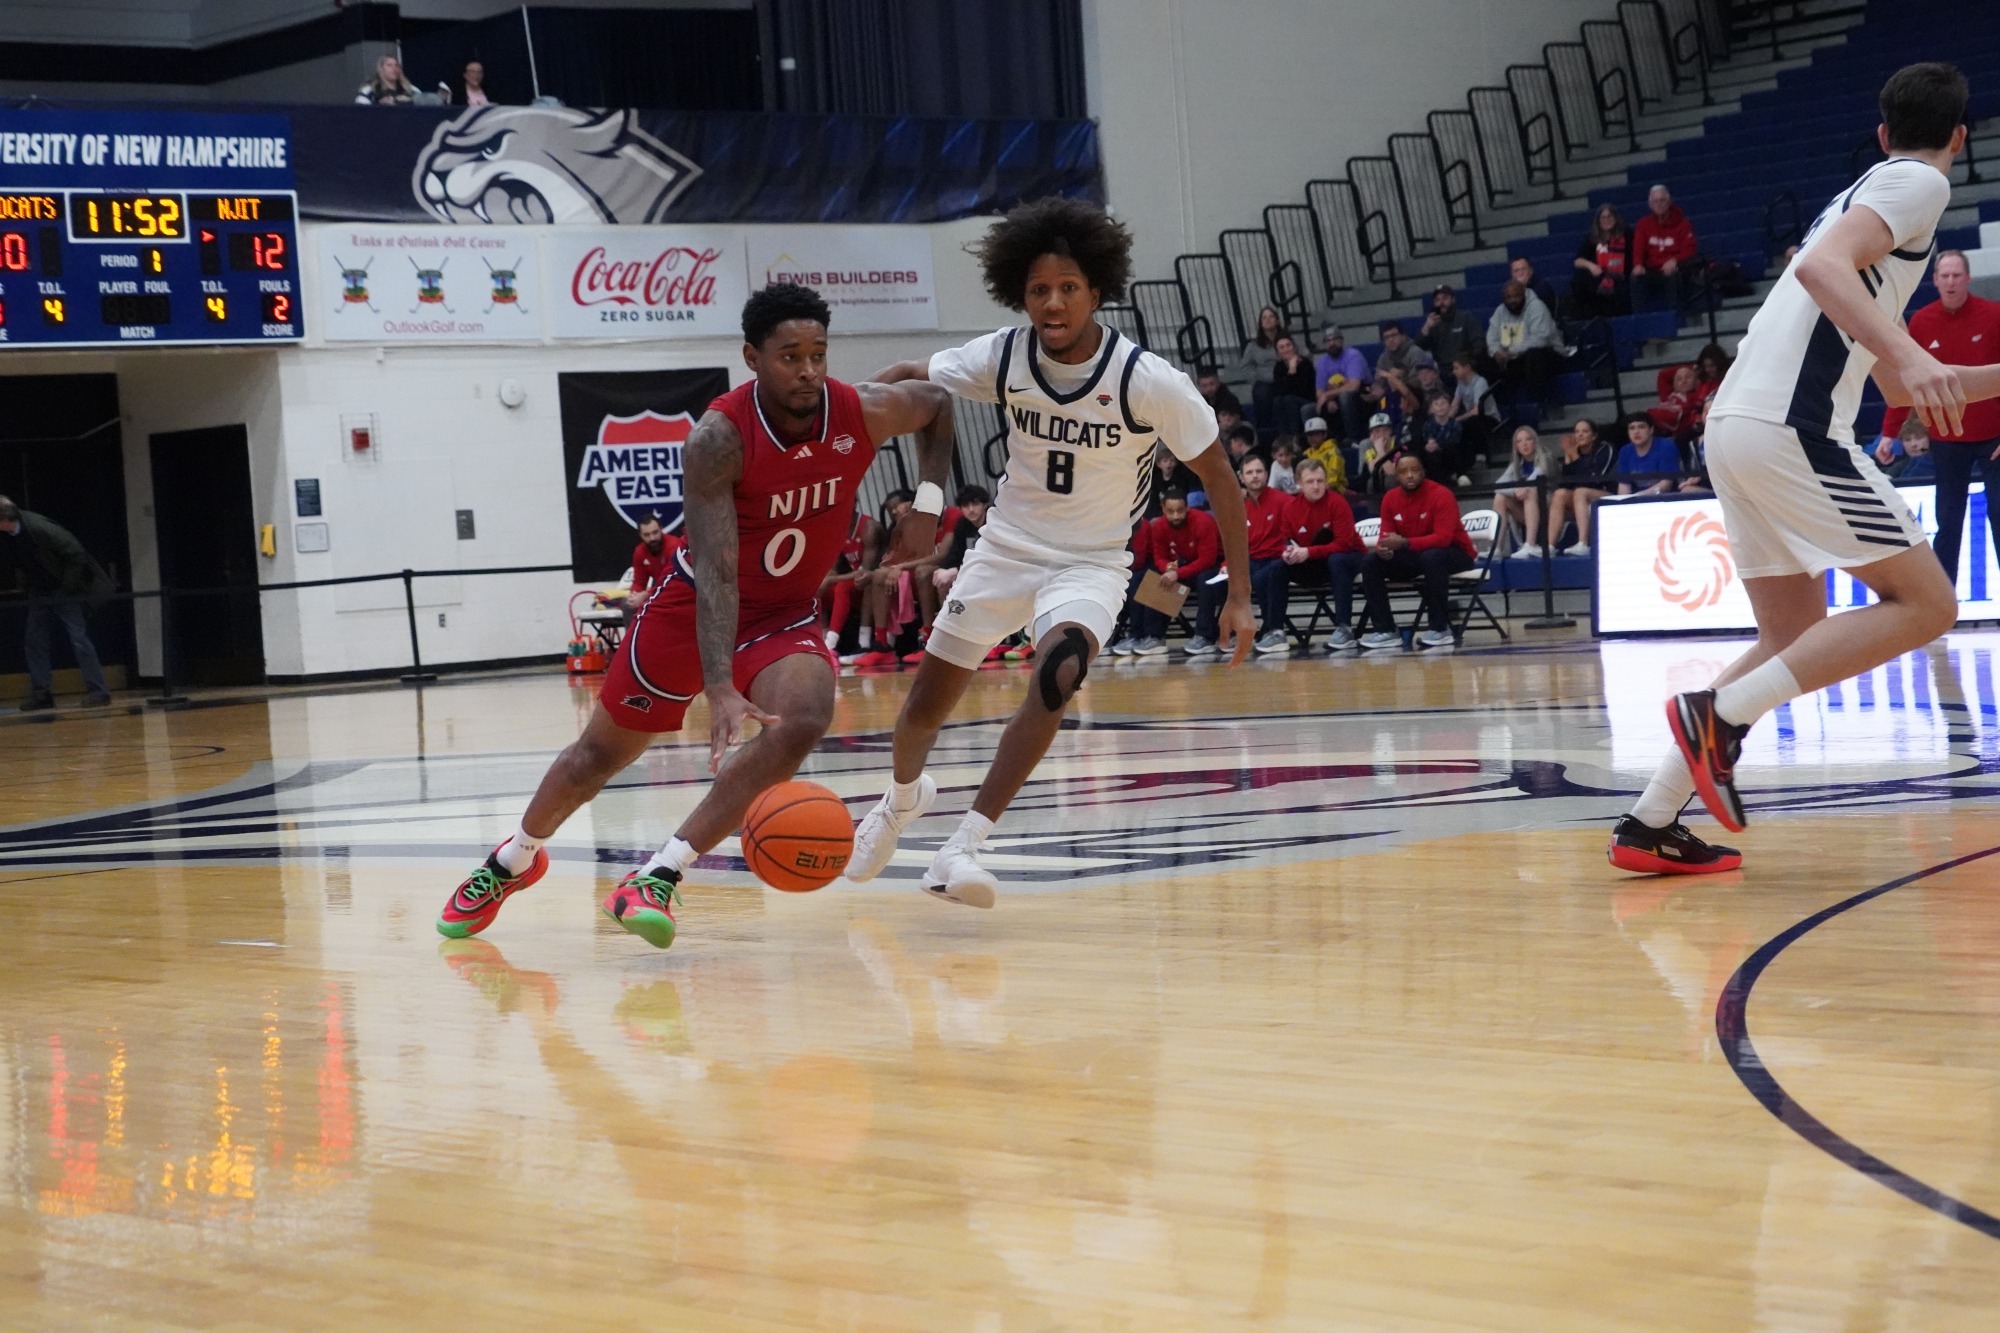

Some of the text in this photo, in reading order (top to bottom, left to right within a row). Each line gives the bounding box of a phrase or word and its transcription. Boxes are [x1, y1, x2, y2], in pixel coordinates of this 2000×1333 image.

[0, 133, 287, 168] ERSITY OF NEW HAMPSHIRE
[87, 199, 180, 236] 11:52
[217, 198, 262, 220] NJIT
[253, 234, 285, 269] 12
[350, 233, 506, 249] Links at Outlook Golf Course
[100, 254, 139, 268] PERIOD
[152, 250, 162, 273] 1
[200, 280, 228, 293] T.O.L.
[258, 280, 291, 292] FOULS
[572, 246, 723, 306] Coca-Cola
[766, 269, 919, 286] LEWIS BUILDERS
[37, 281, 66, 295] T.O.L.
[98, 281, 172, 294] PLAYER FOUL
[44, 299, 64, 322] 4
[207, 297, 226, 320] 4
[273, 295, 289, 321] 2
[600, 310, 696, 322] ZERO SUGAR
[120, 327, 155, 339] MATCH
[262, 324, 294, 336] SCORE
[383, 320, 484, 334] OutlookGolf.com
[1010, 405, 1122, 449] WILDCATS
[1046, 449, 1075, 495] 8
[768, 476, 842, 523] NJIT
[763, 527, 807, 577] 0
[795, 850, 848, 870] ELITE
